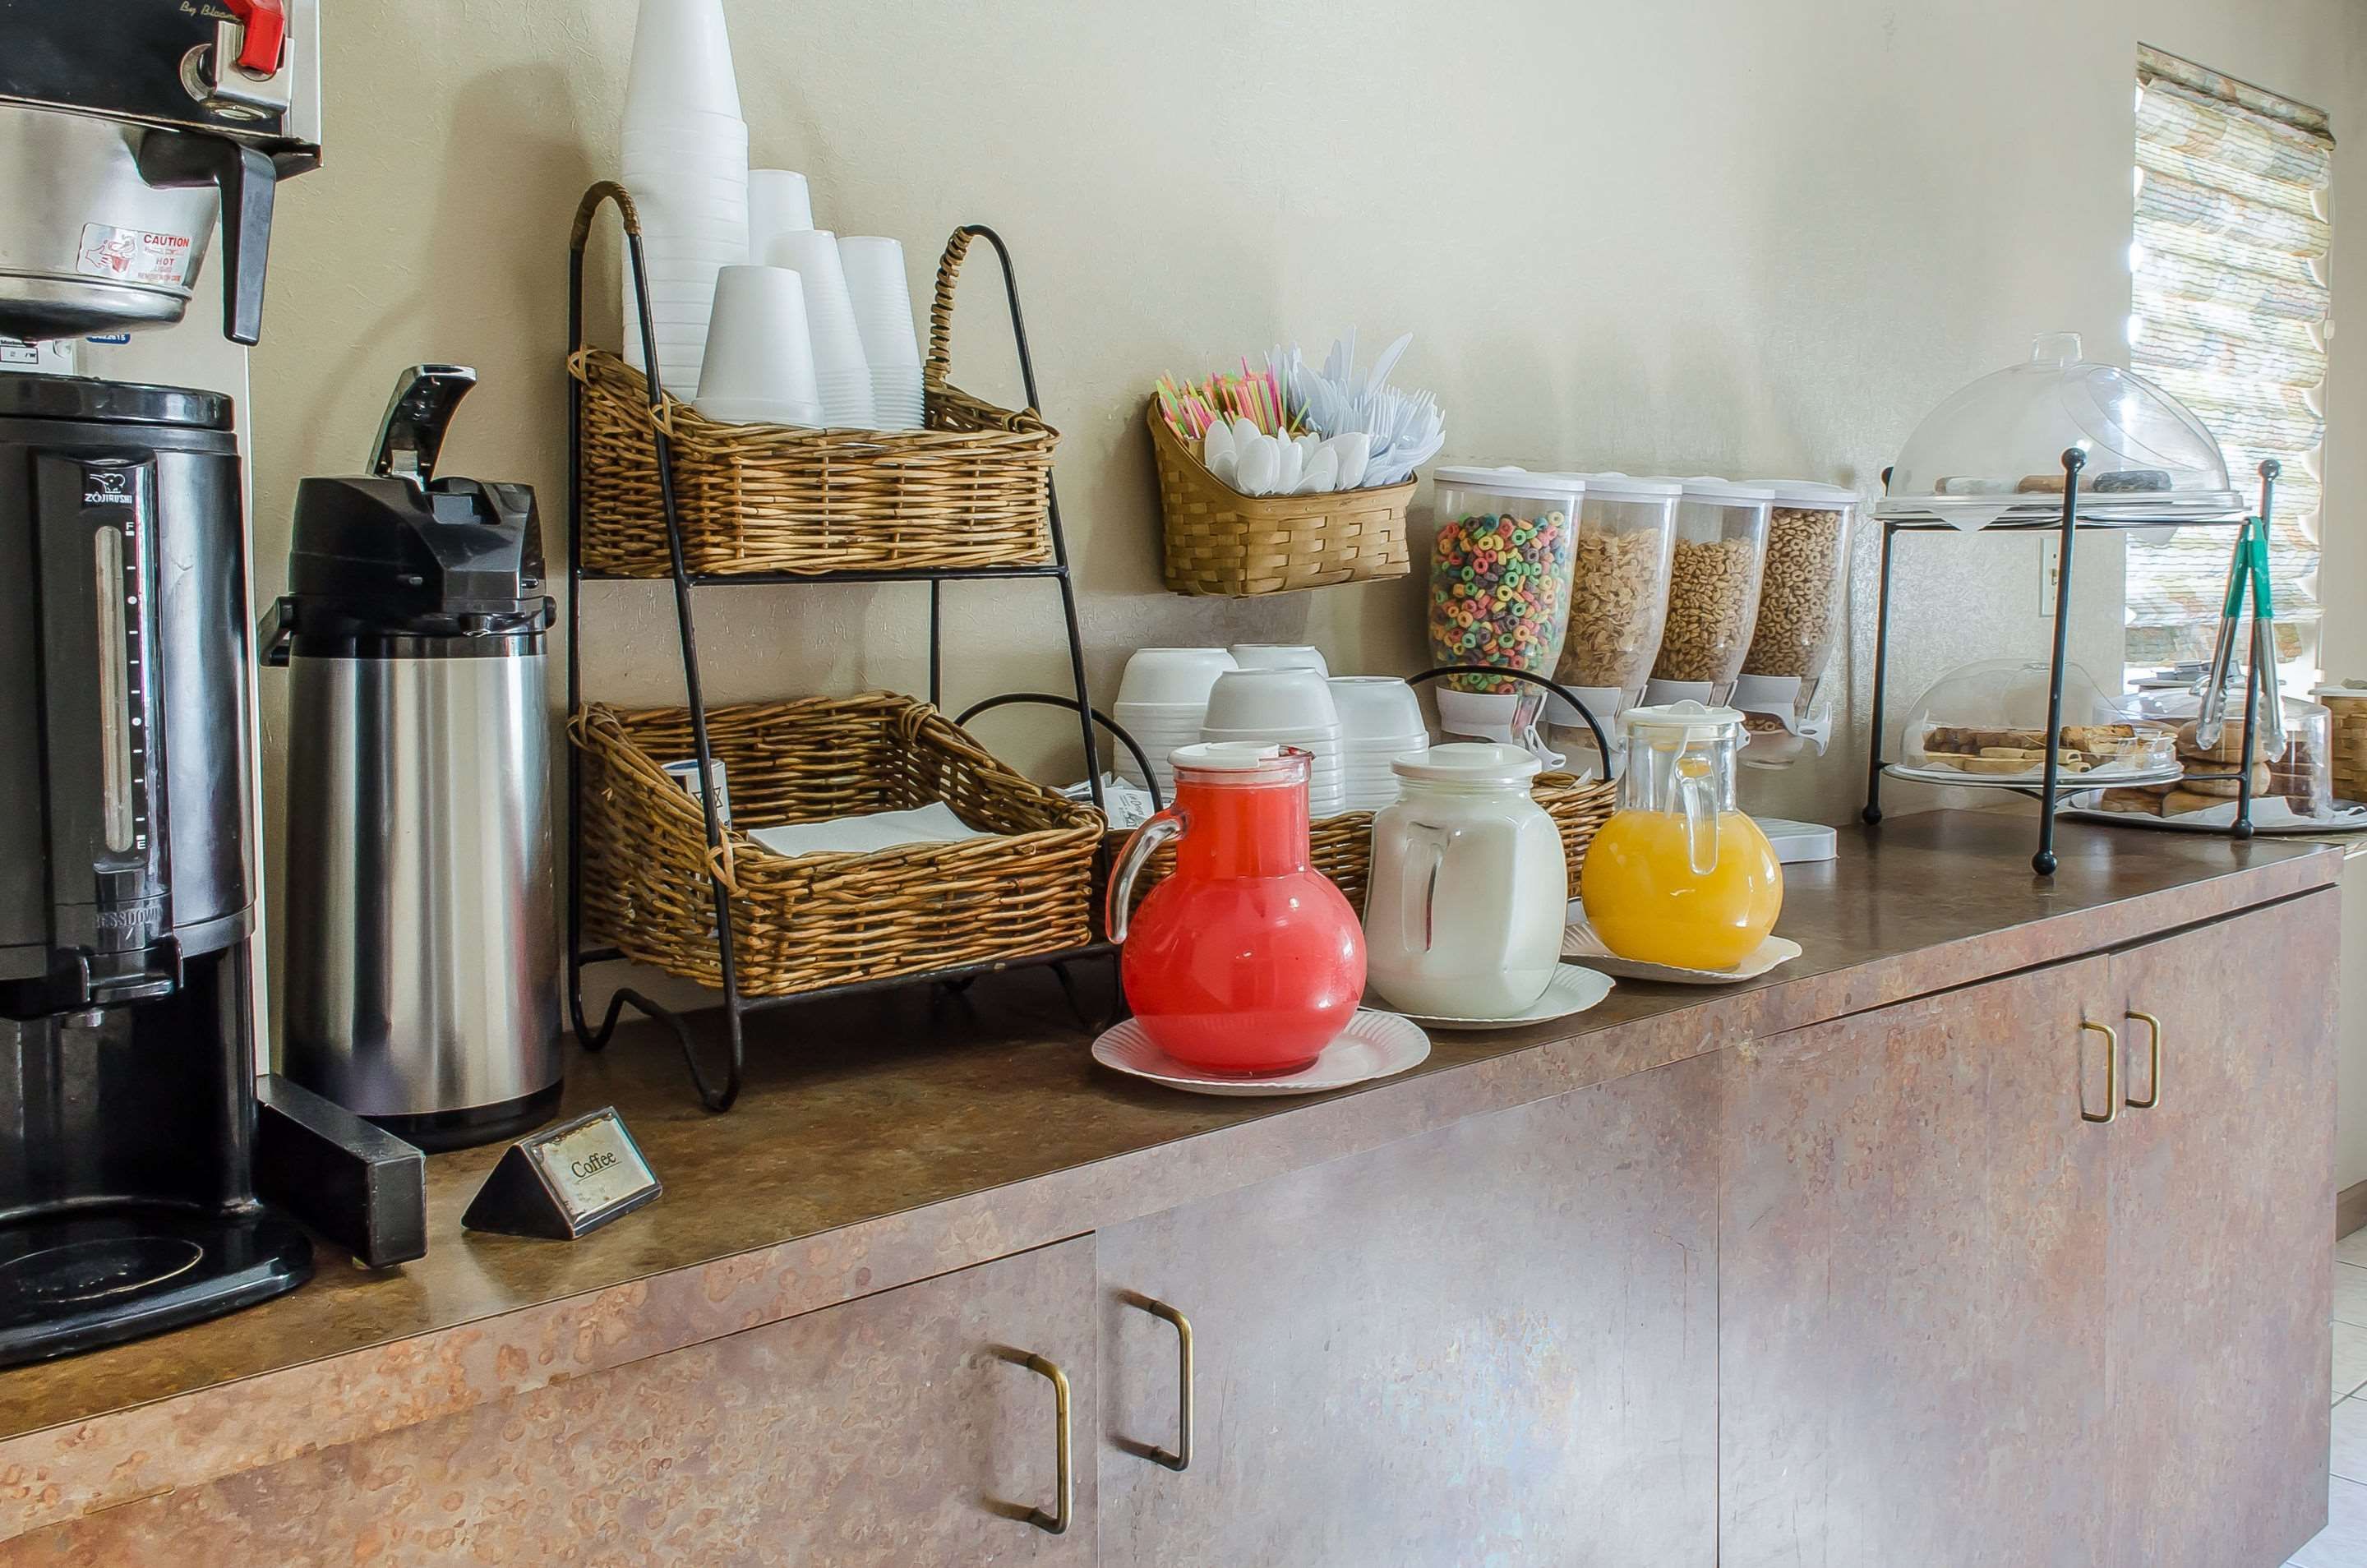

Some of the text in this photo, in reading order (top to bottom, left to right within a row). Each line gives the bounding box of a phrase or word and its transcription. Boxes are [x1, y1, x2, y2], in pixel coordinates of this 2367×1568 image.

[144, 234, 189, 247] CAUTION
[156, 257, 174, 266] HOT
[126, 522, 134, 530] F
[137, 841, 145, 849] E
[571, 1152, 616, 1178] Coffee
